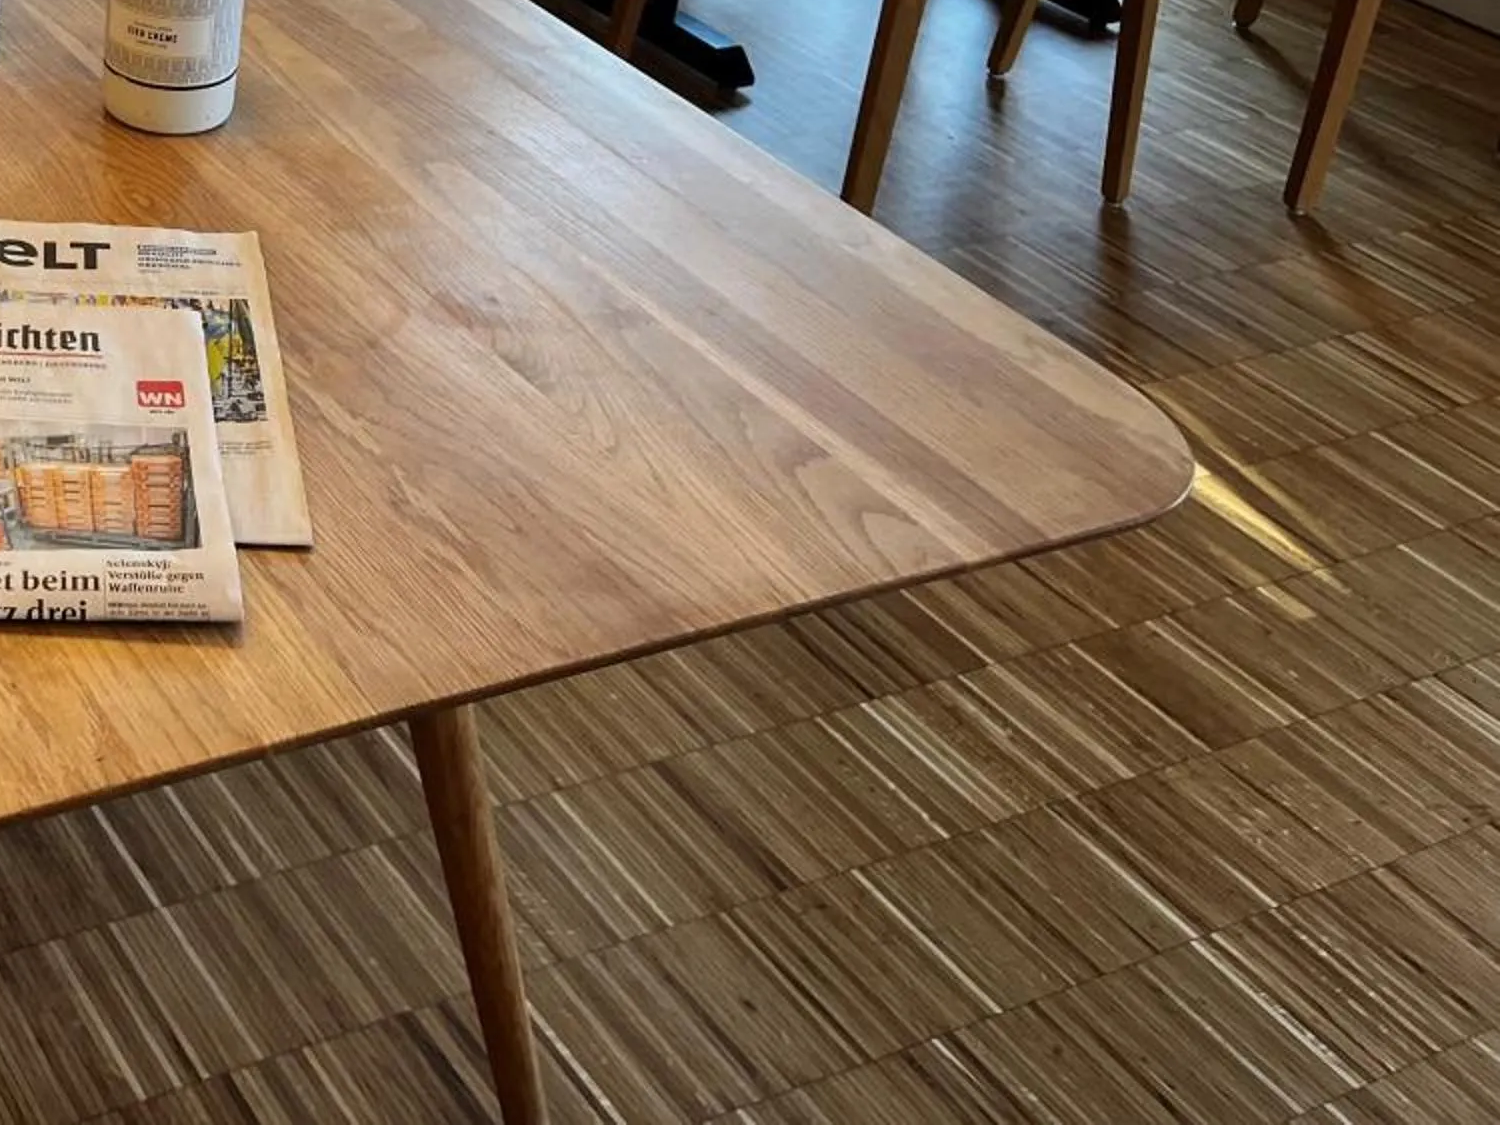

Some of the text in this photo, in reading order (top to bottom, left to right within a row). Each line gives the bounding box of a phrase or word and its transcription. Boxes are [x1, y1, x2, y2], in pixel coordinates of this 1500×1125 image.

[139, 390, 182, 407] WN
[23, 568, 100, 591] beim
[25, 598, 88, 622] drei
